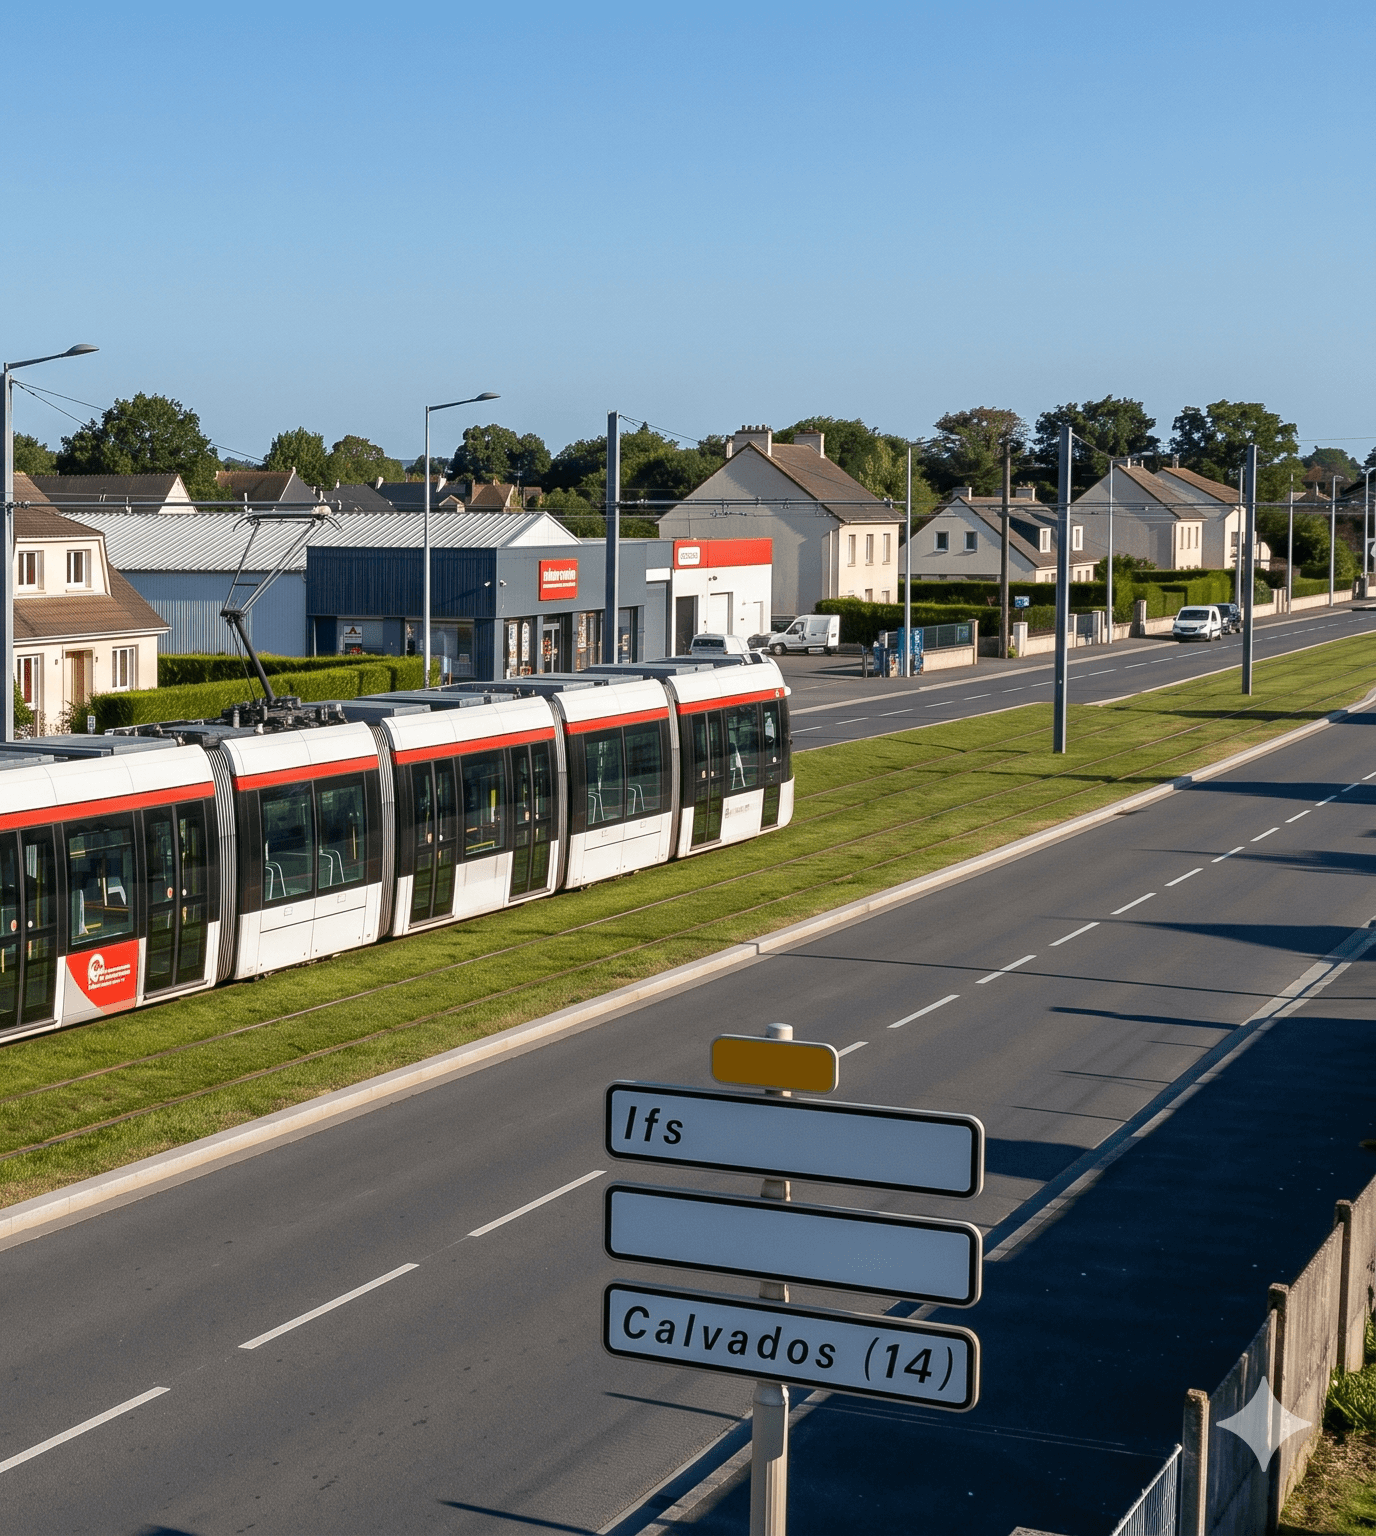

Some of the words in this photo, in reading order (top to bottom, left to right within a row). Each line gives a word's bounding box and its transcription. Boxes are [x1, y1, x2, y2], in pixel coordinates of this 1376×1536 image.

[623, 1105, 684, 1145] Ifs
[622, 1304, 837, 1370] Calvados
[863, 1336, 954, 1392] (14)
